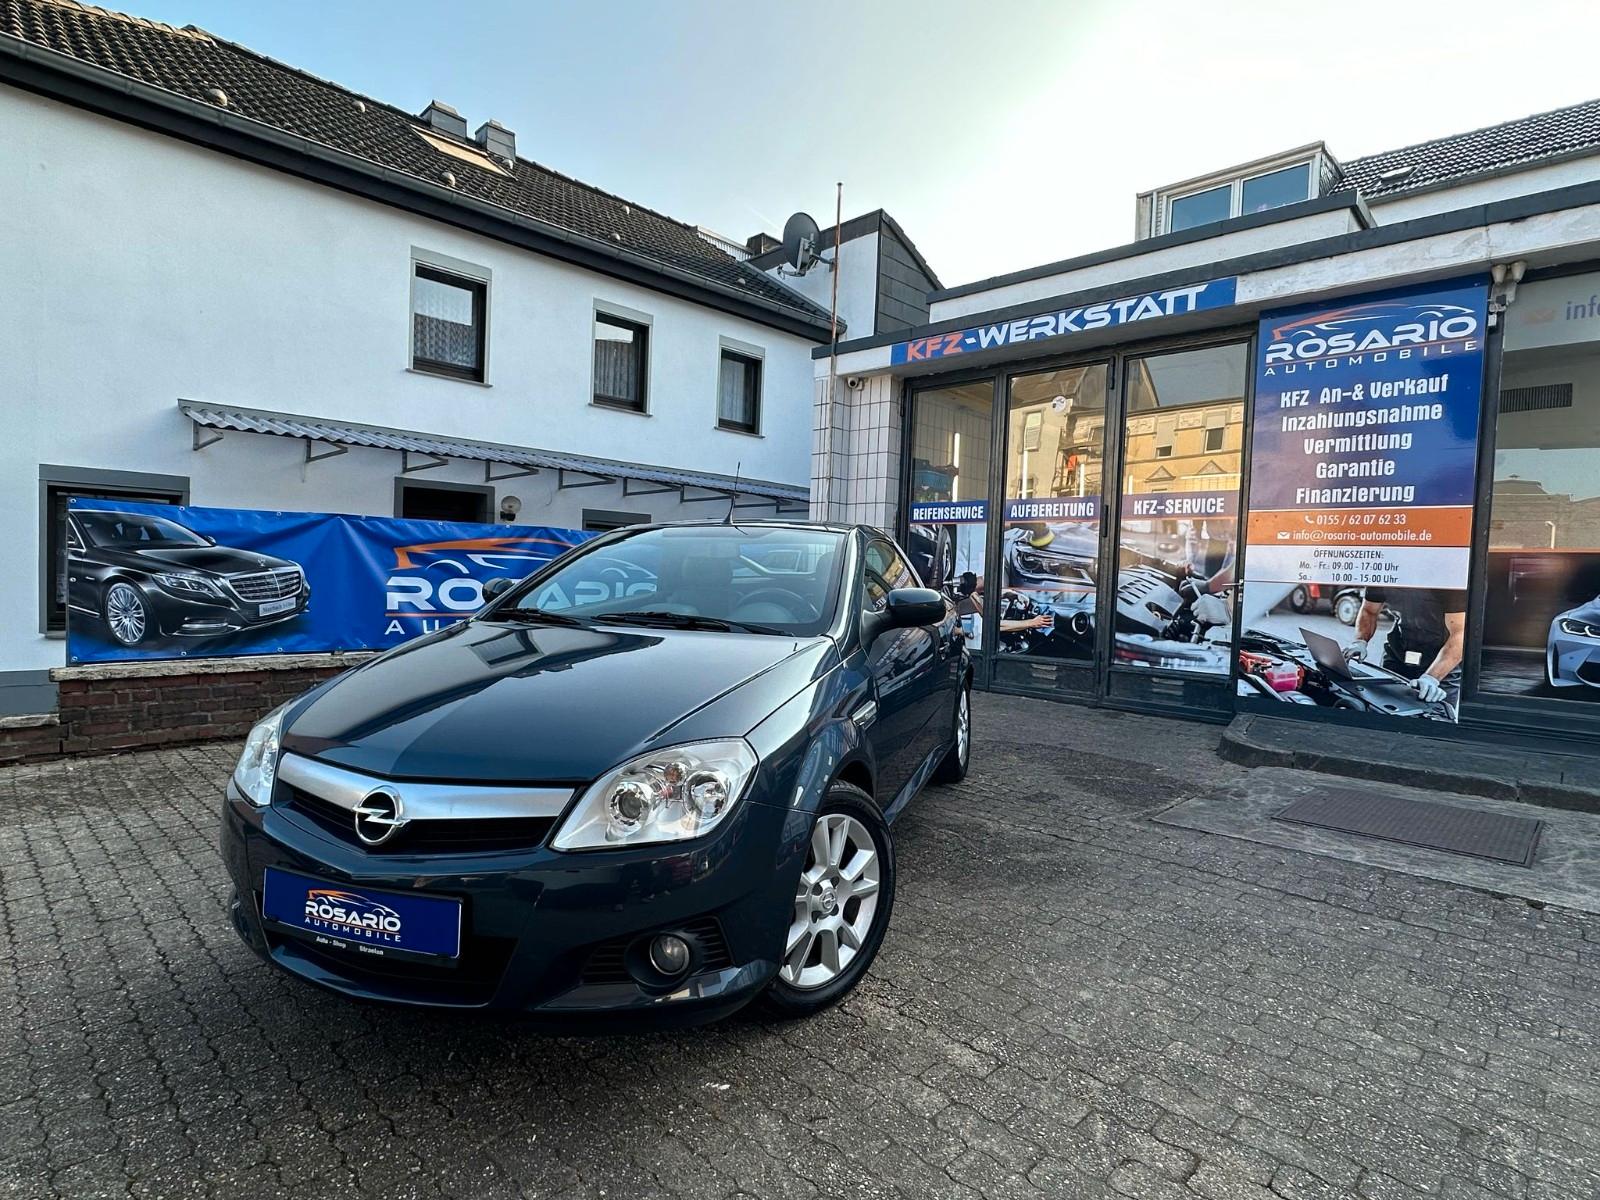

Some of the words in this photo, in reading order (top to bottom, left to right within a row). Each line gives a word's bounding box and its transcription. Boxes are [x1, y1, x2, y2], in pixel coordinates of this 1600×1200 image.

[906, 283, 1208, 362] KFZ-WERKSTATT
[1265, 315, 1478, 364] ROSARIO
[1264, 340, 1478, 377] AUTOMOBILE
[1280, 389, 1310, 409] KFZ
[1369, 373, 1449, 398] Verkauf
[1281, 403, 1443, 432] Inzahlungsnahme
[1303, 431, 1412, 455] Vermittlung
[1316, 459, 1395, 479] Garantie
[1296, 484, 1415, 505] Finanzierung
[913, 505, 984, 521] REIFENSERVICE
[1010, 501, 1094, 518] AUFBEREITUNG
[1133, 497, 1225, 515] KFZ-SERVICE
[1316, 514, 1339, 525] 0155
[1341, 514, 1346, 526] /
[1348, 514, 1361, 525] 62
[1363, 514, 1376, 525] 07
[1378, 514, 1391, 525] 62
[1393, 513, 1406, 525] 33
[1292, 529, 1432, 542] info@rosario-automobile.de
[1313, 548, 1384, 559] ÖFFNUNGSZEITEN:
[1299, 561, 1312, 569] Mo.
[1384, 562, 1400, 572] Uhr
[1383, 574, 1399, 583] Uhr
[305, 900, 401, 932] ROSARIO
[304, 916, 401, 942] AUTOMOBILE
